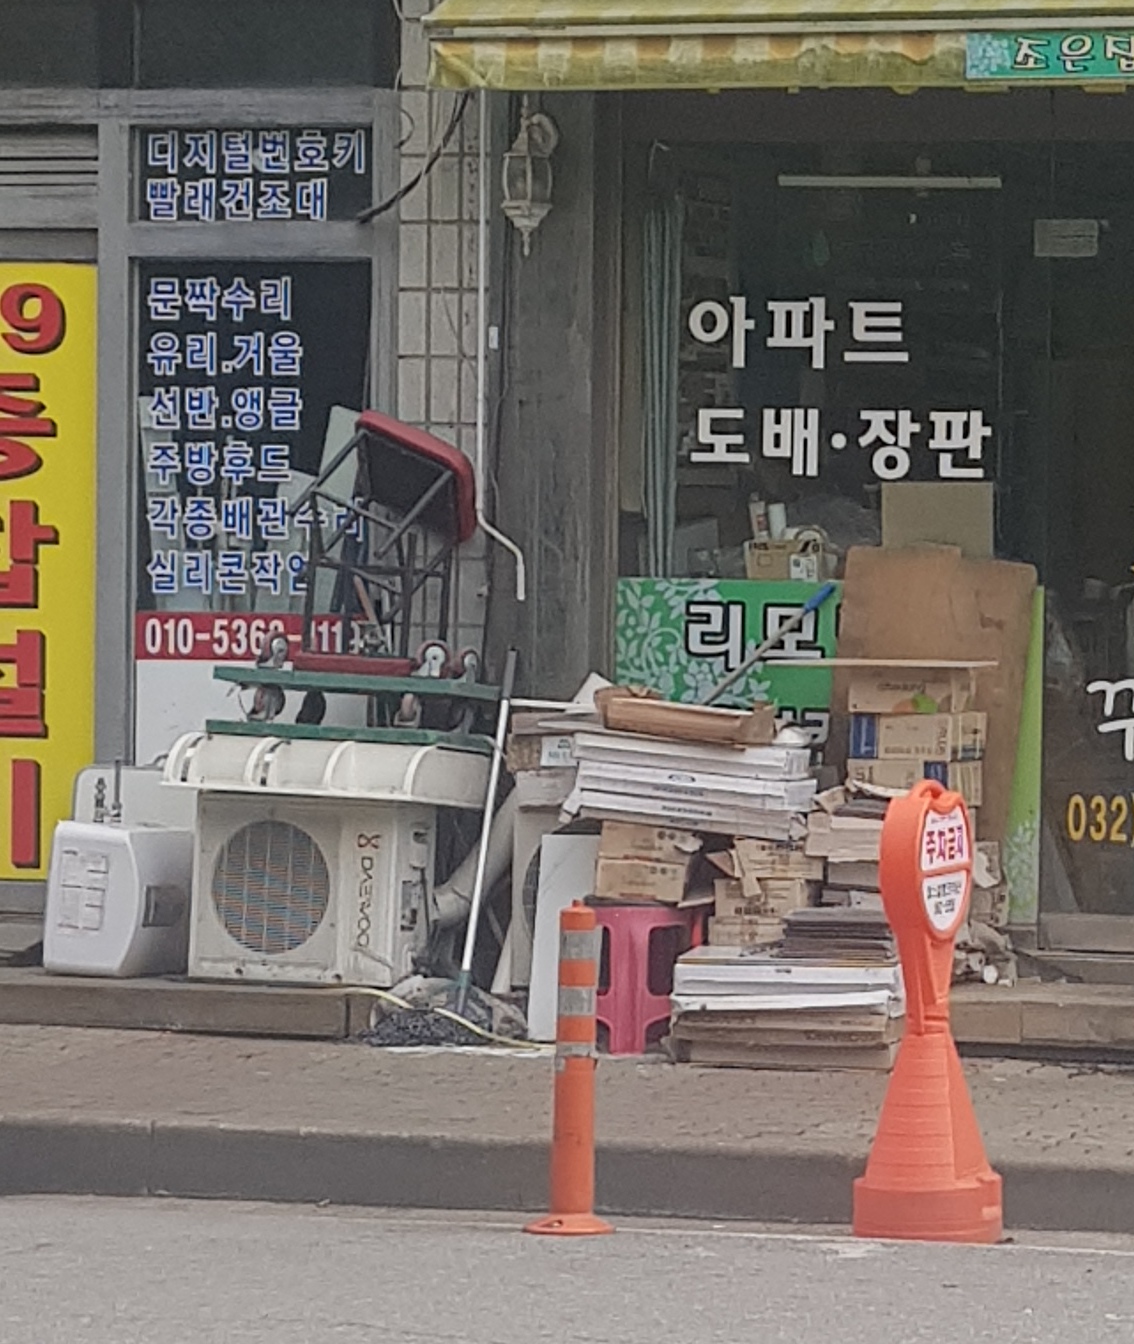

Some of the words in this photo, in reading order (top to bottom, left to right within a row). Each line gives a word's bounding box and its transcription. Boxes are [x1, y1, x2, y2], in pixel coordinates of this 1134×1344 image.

[148, 130, 365, 175] 디지털번호키
[147, 178, 328, 222] 빨래건조대
[148, 276, 291, 321] 문짝수리
[688, 296, 910, 370] 아파트
[148, 441, 291, 485] 주방후드
[684, 600, 828, 672] 리모
